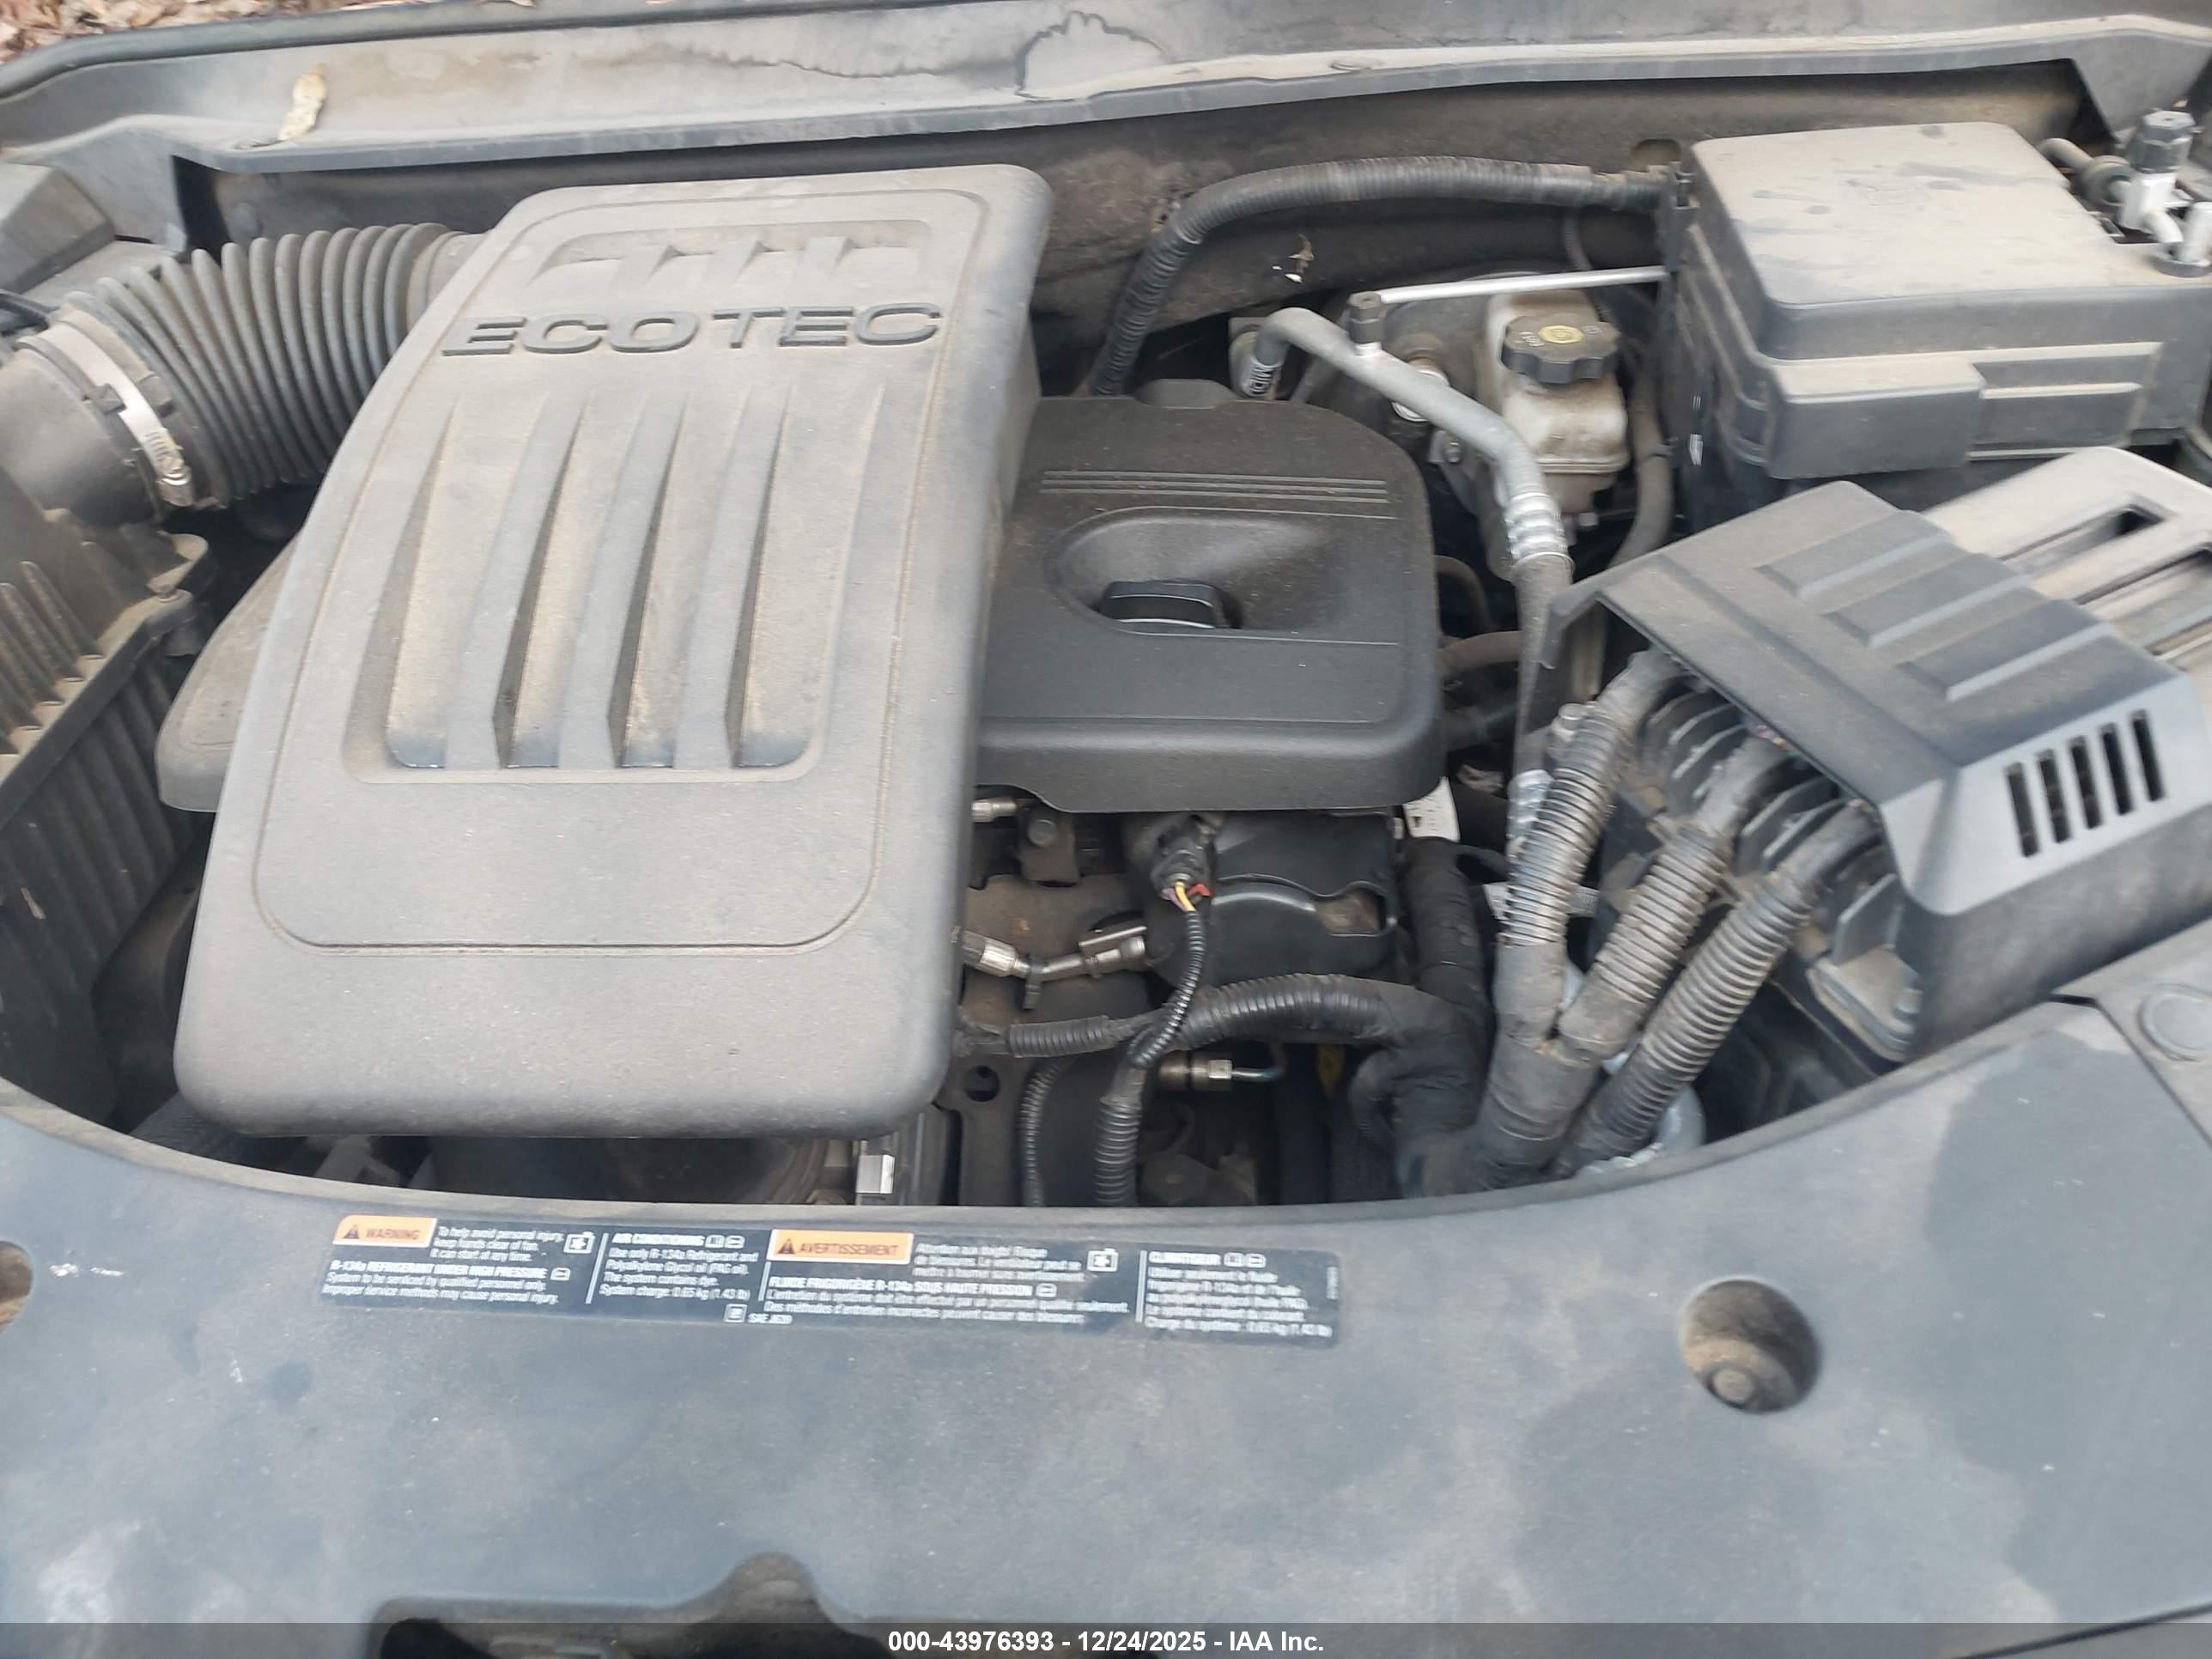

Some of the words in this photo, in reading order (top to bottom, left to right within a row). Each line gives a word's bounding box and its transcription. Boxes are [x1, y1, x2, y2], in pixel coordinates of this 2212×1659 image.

[441, 301, 941, 356] ECOTEC
[367, 1229, 421, 1239] WARNING
[799, 1243, 899, 1255] AVERTISSEMENT
